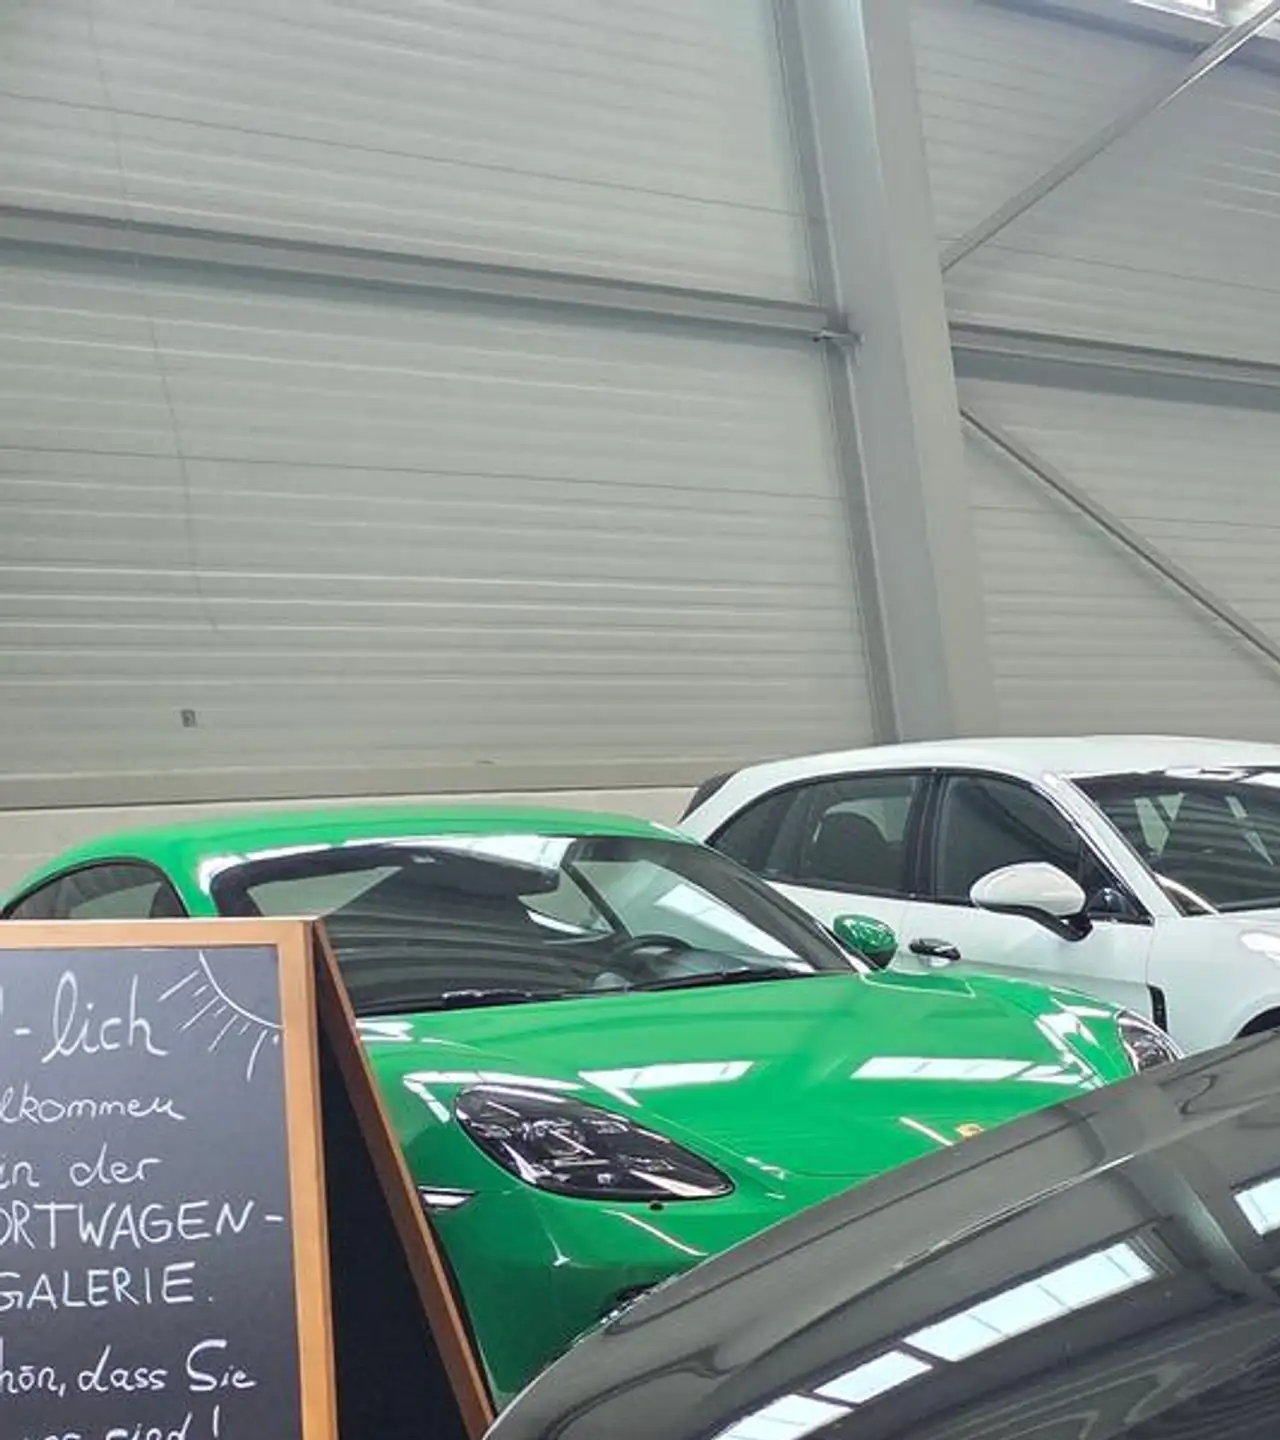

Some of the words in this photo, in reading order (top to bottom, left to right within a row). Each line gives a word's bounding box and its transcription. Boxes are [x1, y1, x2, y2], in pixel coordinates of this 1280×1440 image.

[69, 1142, 163, 1187] der
[77, 1344, 168, 1391] dass
[186, 1338, 258, 1392] Sie
